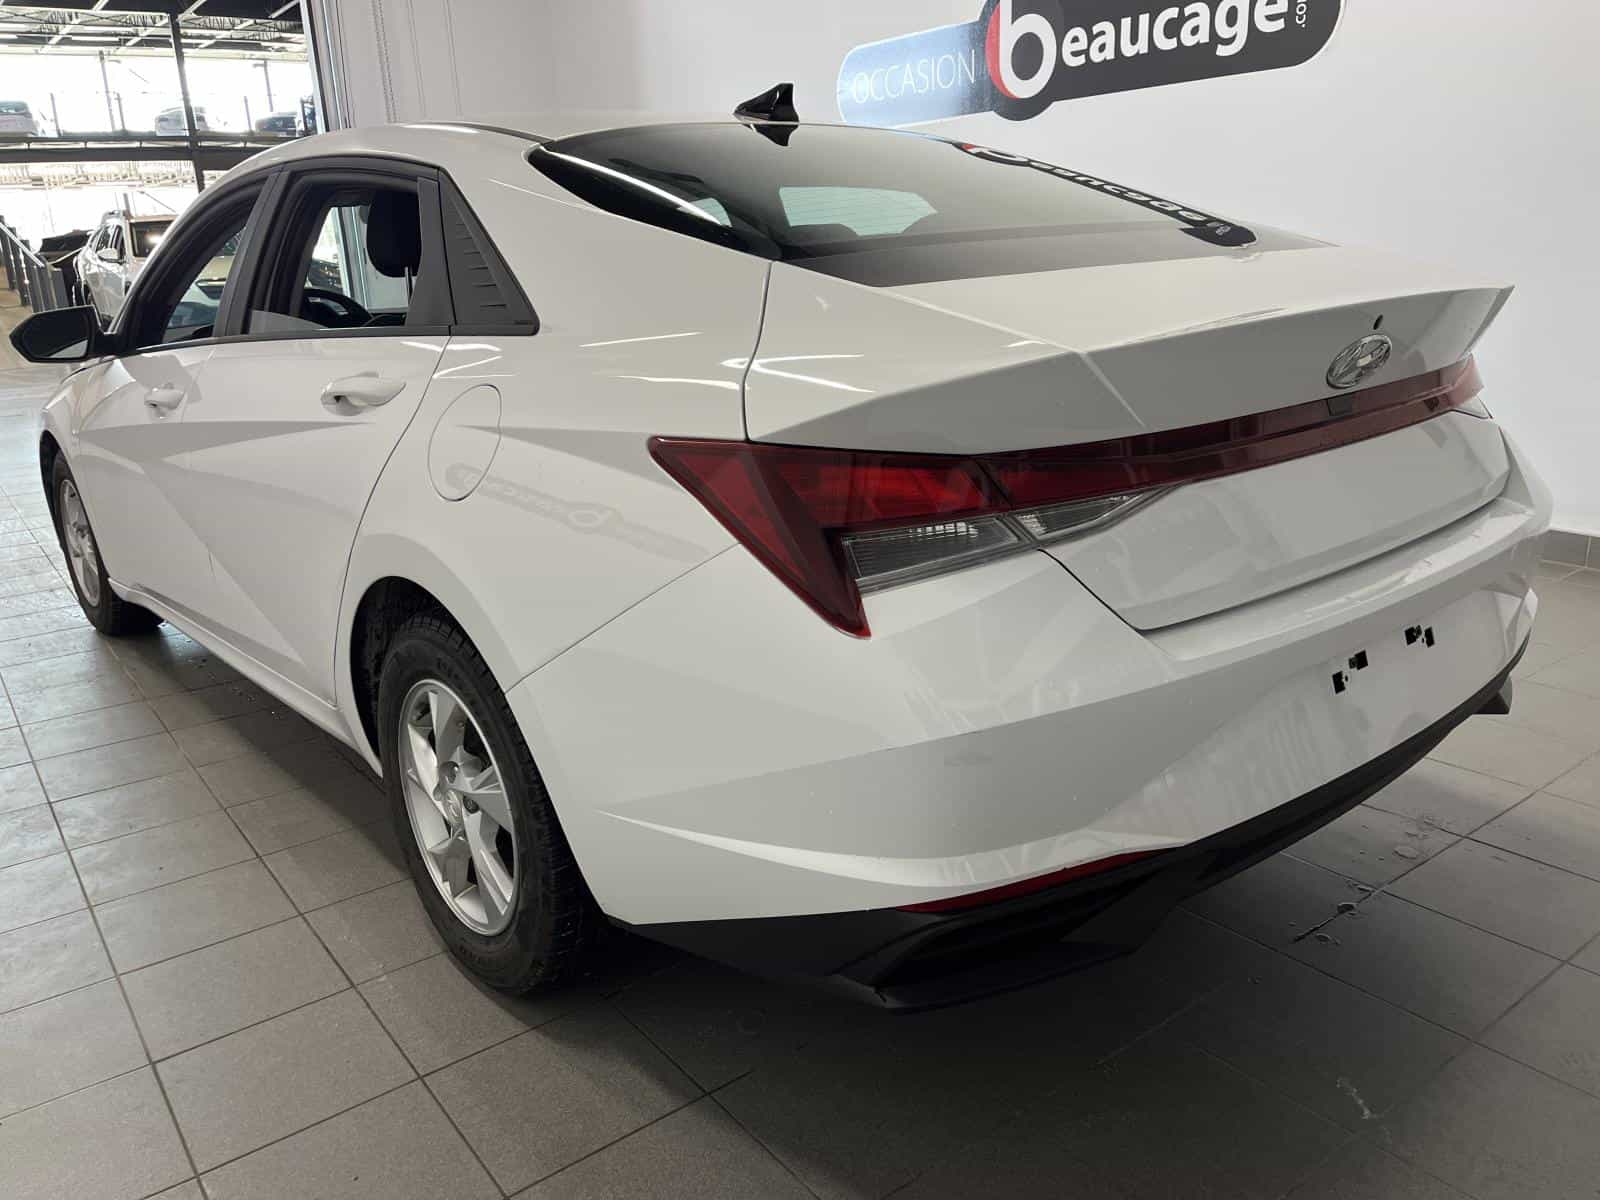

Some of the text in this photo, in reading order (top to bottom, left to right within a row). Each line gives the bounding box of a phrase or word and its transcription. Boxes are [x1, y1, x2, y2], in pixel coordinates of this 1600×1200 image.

[1295, 0, 1307, 28] .co
[853, 0, 1288, 104] OCCASION beaucage
